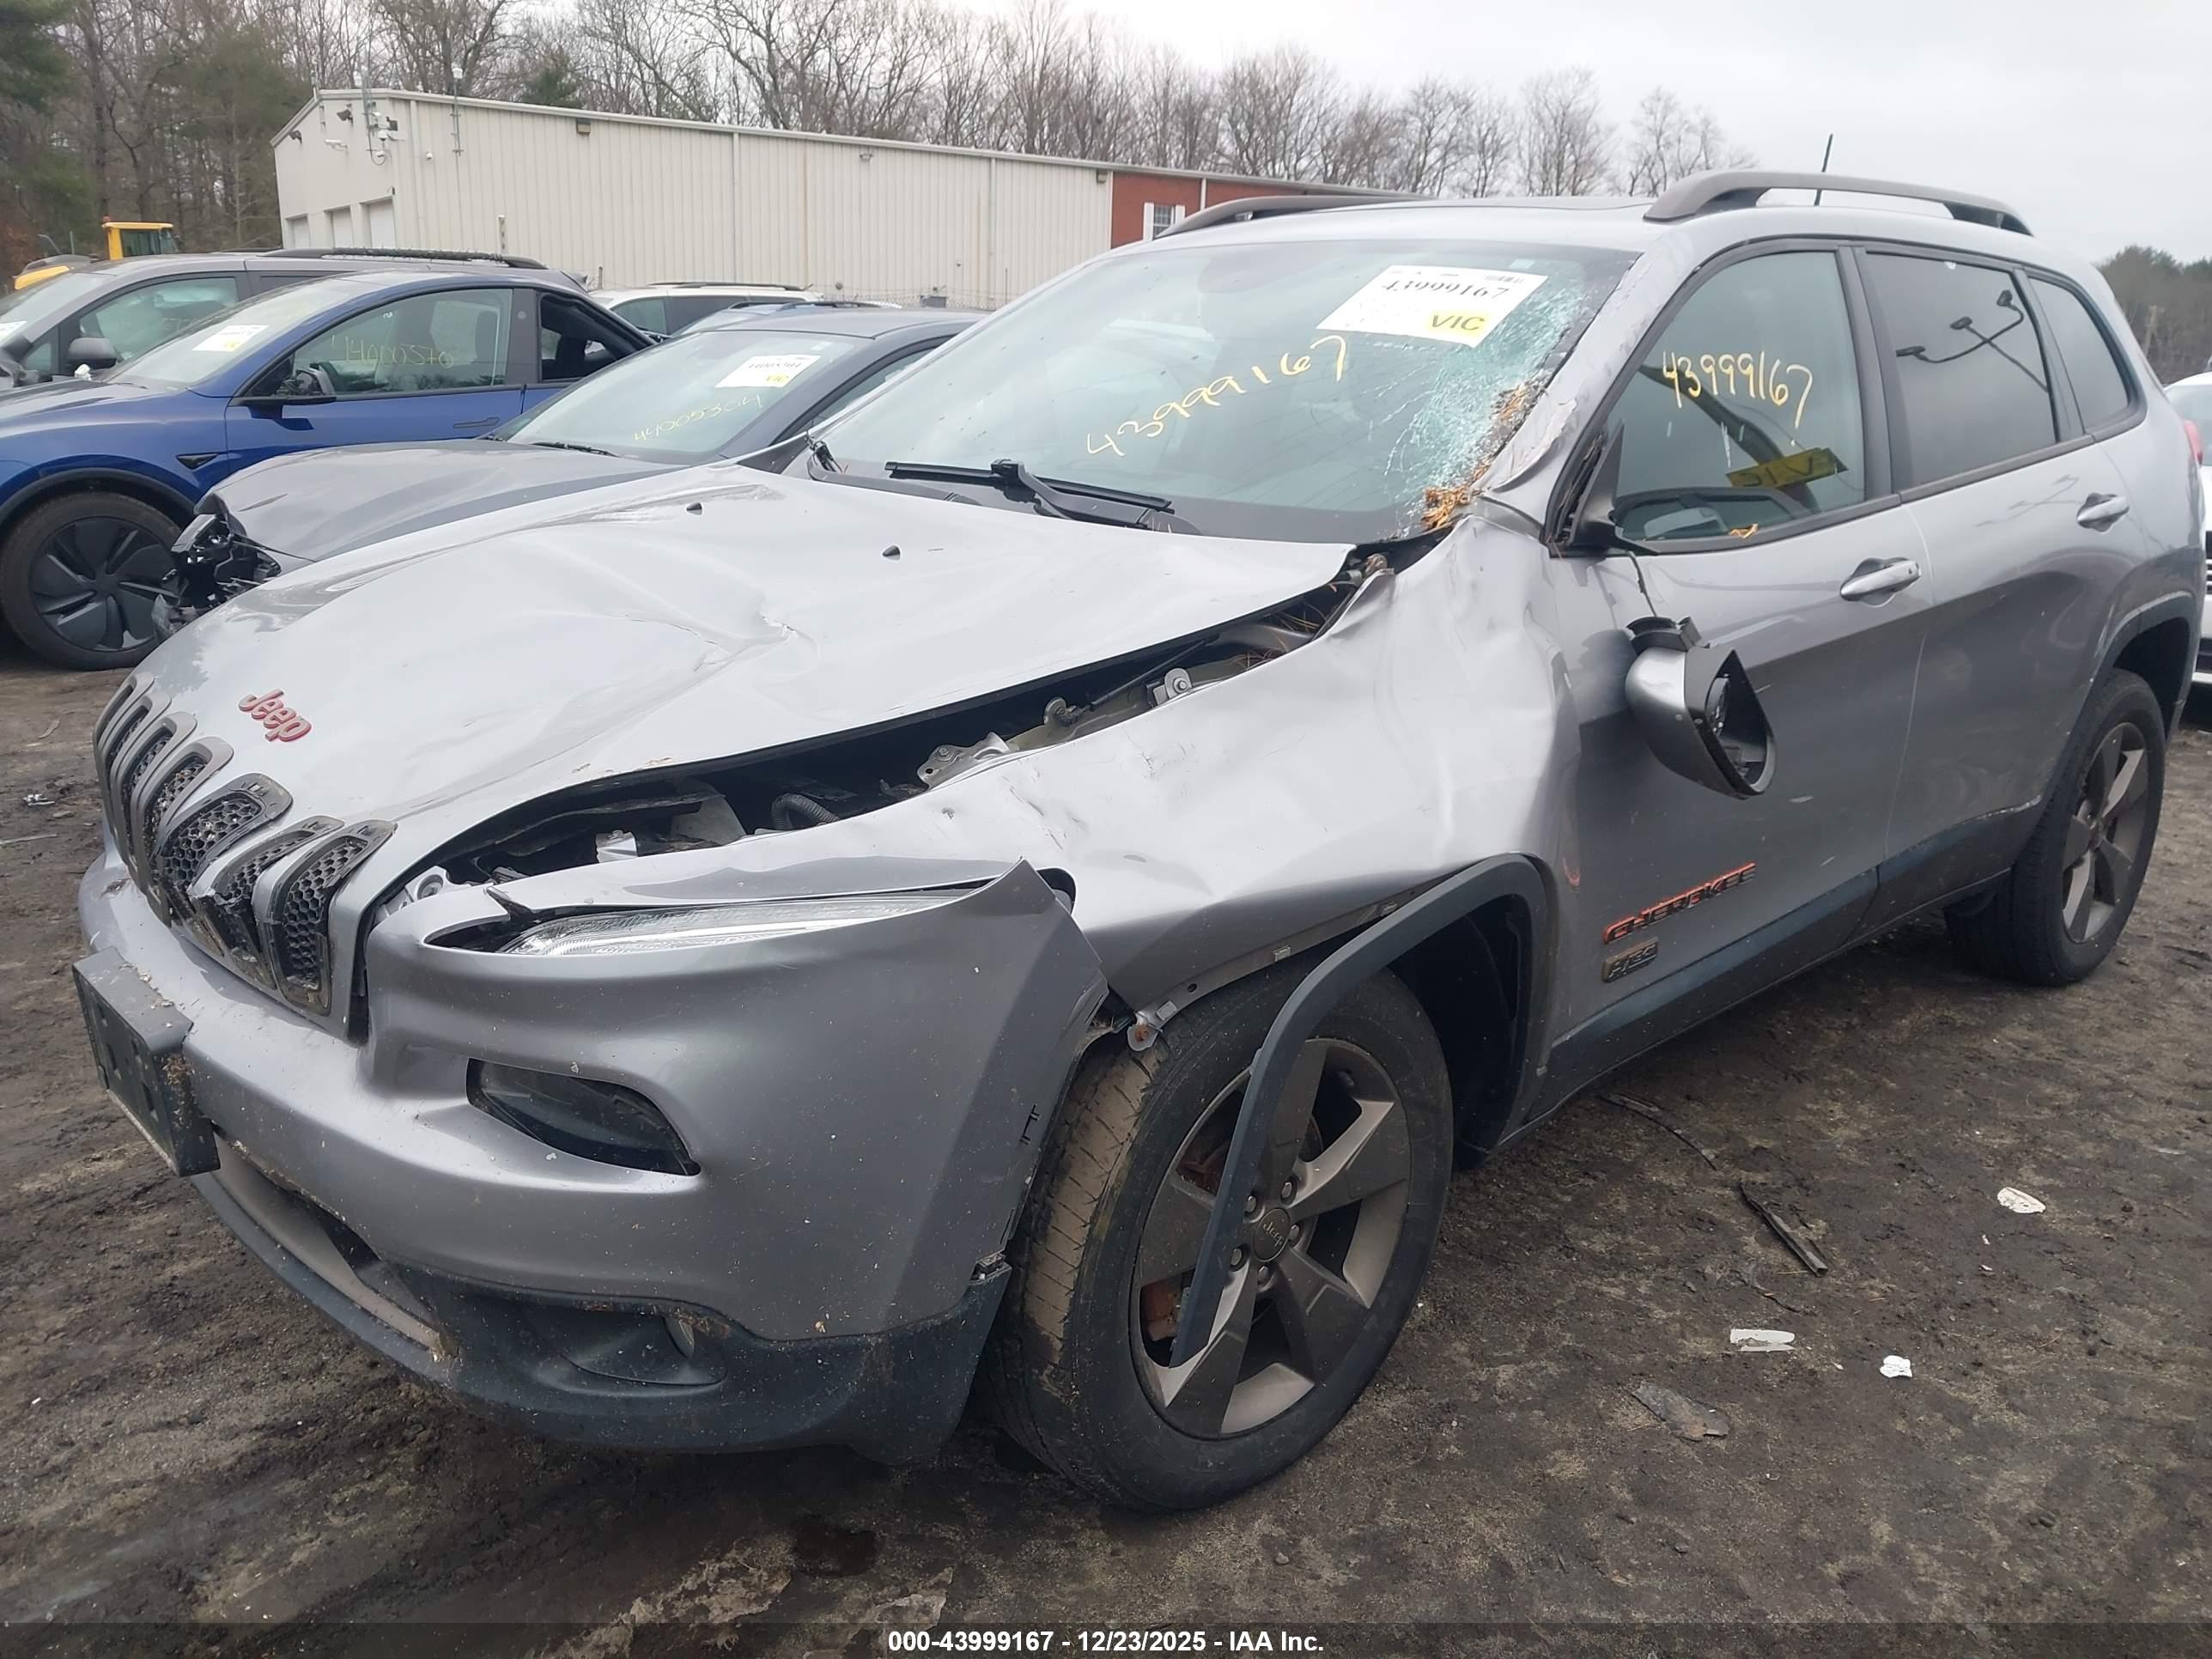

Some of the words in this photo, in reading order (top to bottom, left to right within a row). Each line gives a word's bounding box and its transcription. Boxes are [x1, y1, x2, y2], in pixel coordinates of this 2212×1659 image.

[1431, 314, 1486, 331] VIC
[1087, 335, 1347, 457] 43999167
[1662, 350, 1814, 429] 43999167
[238, 688, 312, 743] Jeep
